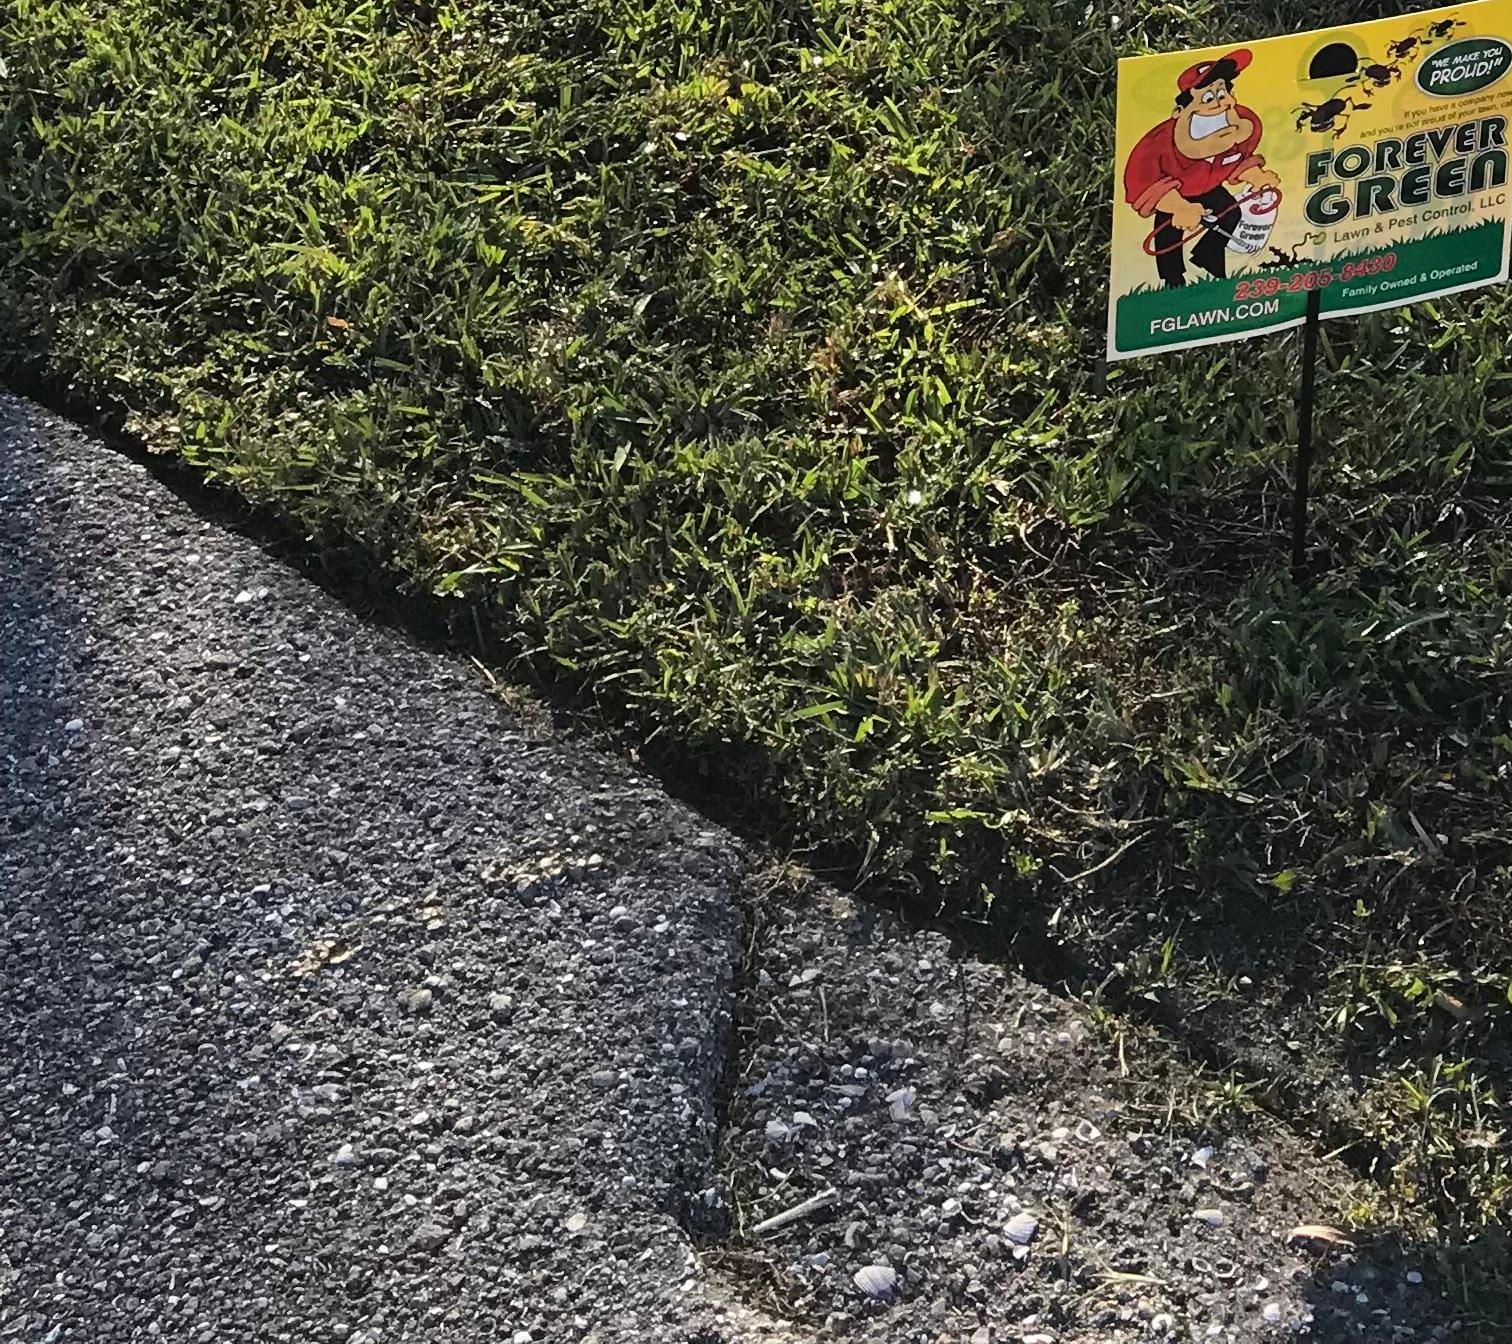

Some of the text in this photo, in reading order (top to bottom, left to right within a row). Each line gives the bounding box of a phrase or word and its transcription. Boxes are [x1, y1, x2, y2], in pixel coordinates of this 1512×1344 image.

[1429, 56, 1504, 87] PROUD!"
[1452, 51, 1480, 65] MAKE
[1483, 46, 1504, 58] YOU
[1360, 127, 1376, 139] and
[1405, 120, 1420, 130] not
[1421, 113, 1446, 127] proud
[1447, 111, 1457, 119] of
[1458, 107, 1478, 120] your
[1410, 108, 1427, 118] you
[1429, 104, 1449, 114] have
[1457, 96, 1494, 109] company
[1305, 115, 1509, 188] FOREVER
[1304, 148, 1509, 227] GREEN
[1240, 230, 1265, 240] Green
[1334, 193, 1506, 243] Lawn & Pest Control, LLC
[1232, 252, 1397, 301] 239-205-8430
[1342, 261, 1478, 298] Family Owned & Operated
[1150, 298, 1280, 335] FGLAWN.COM
